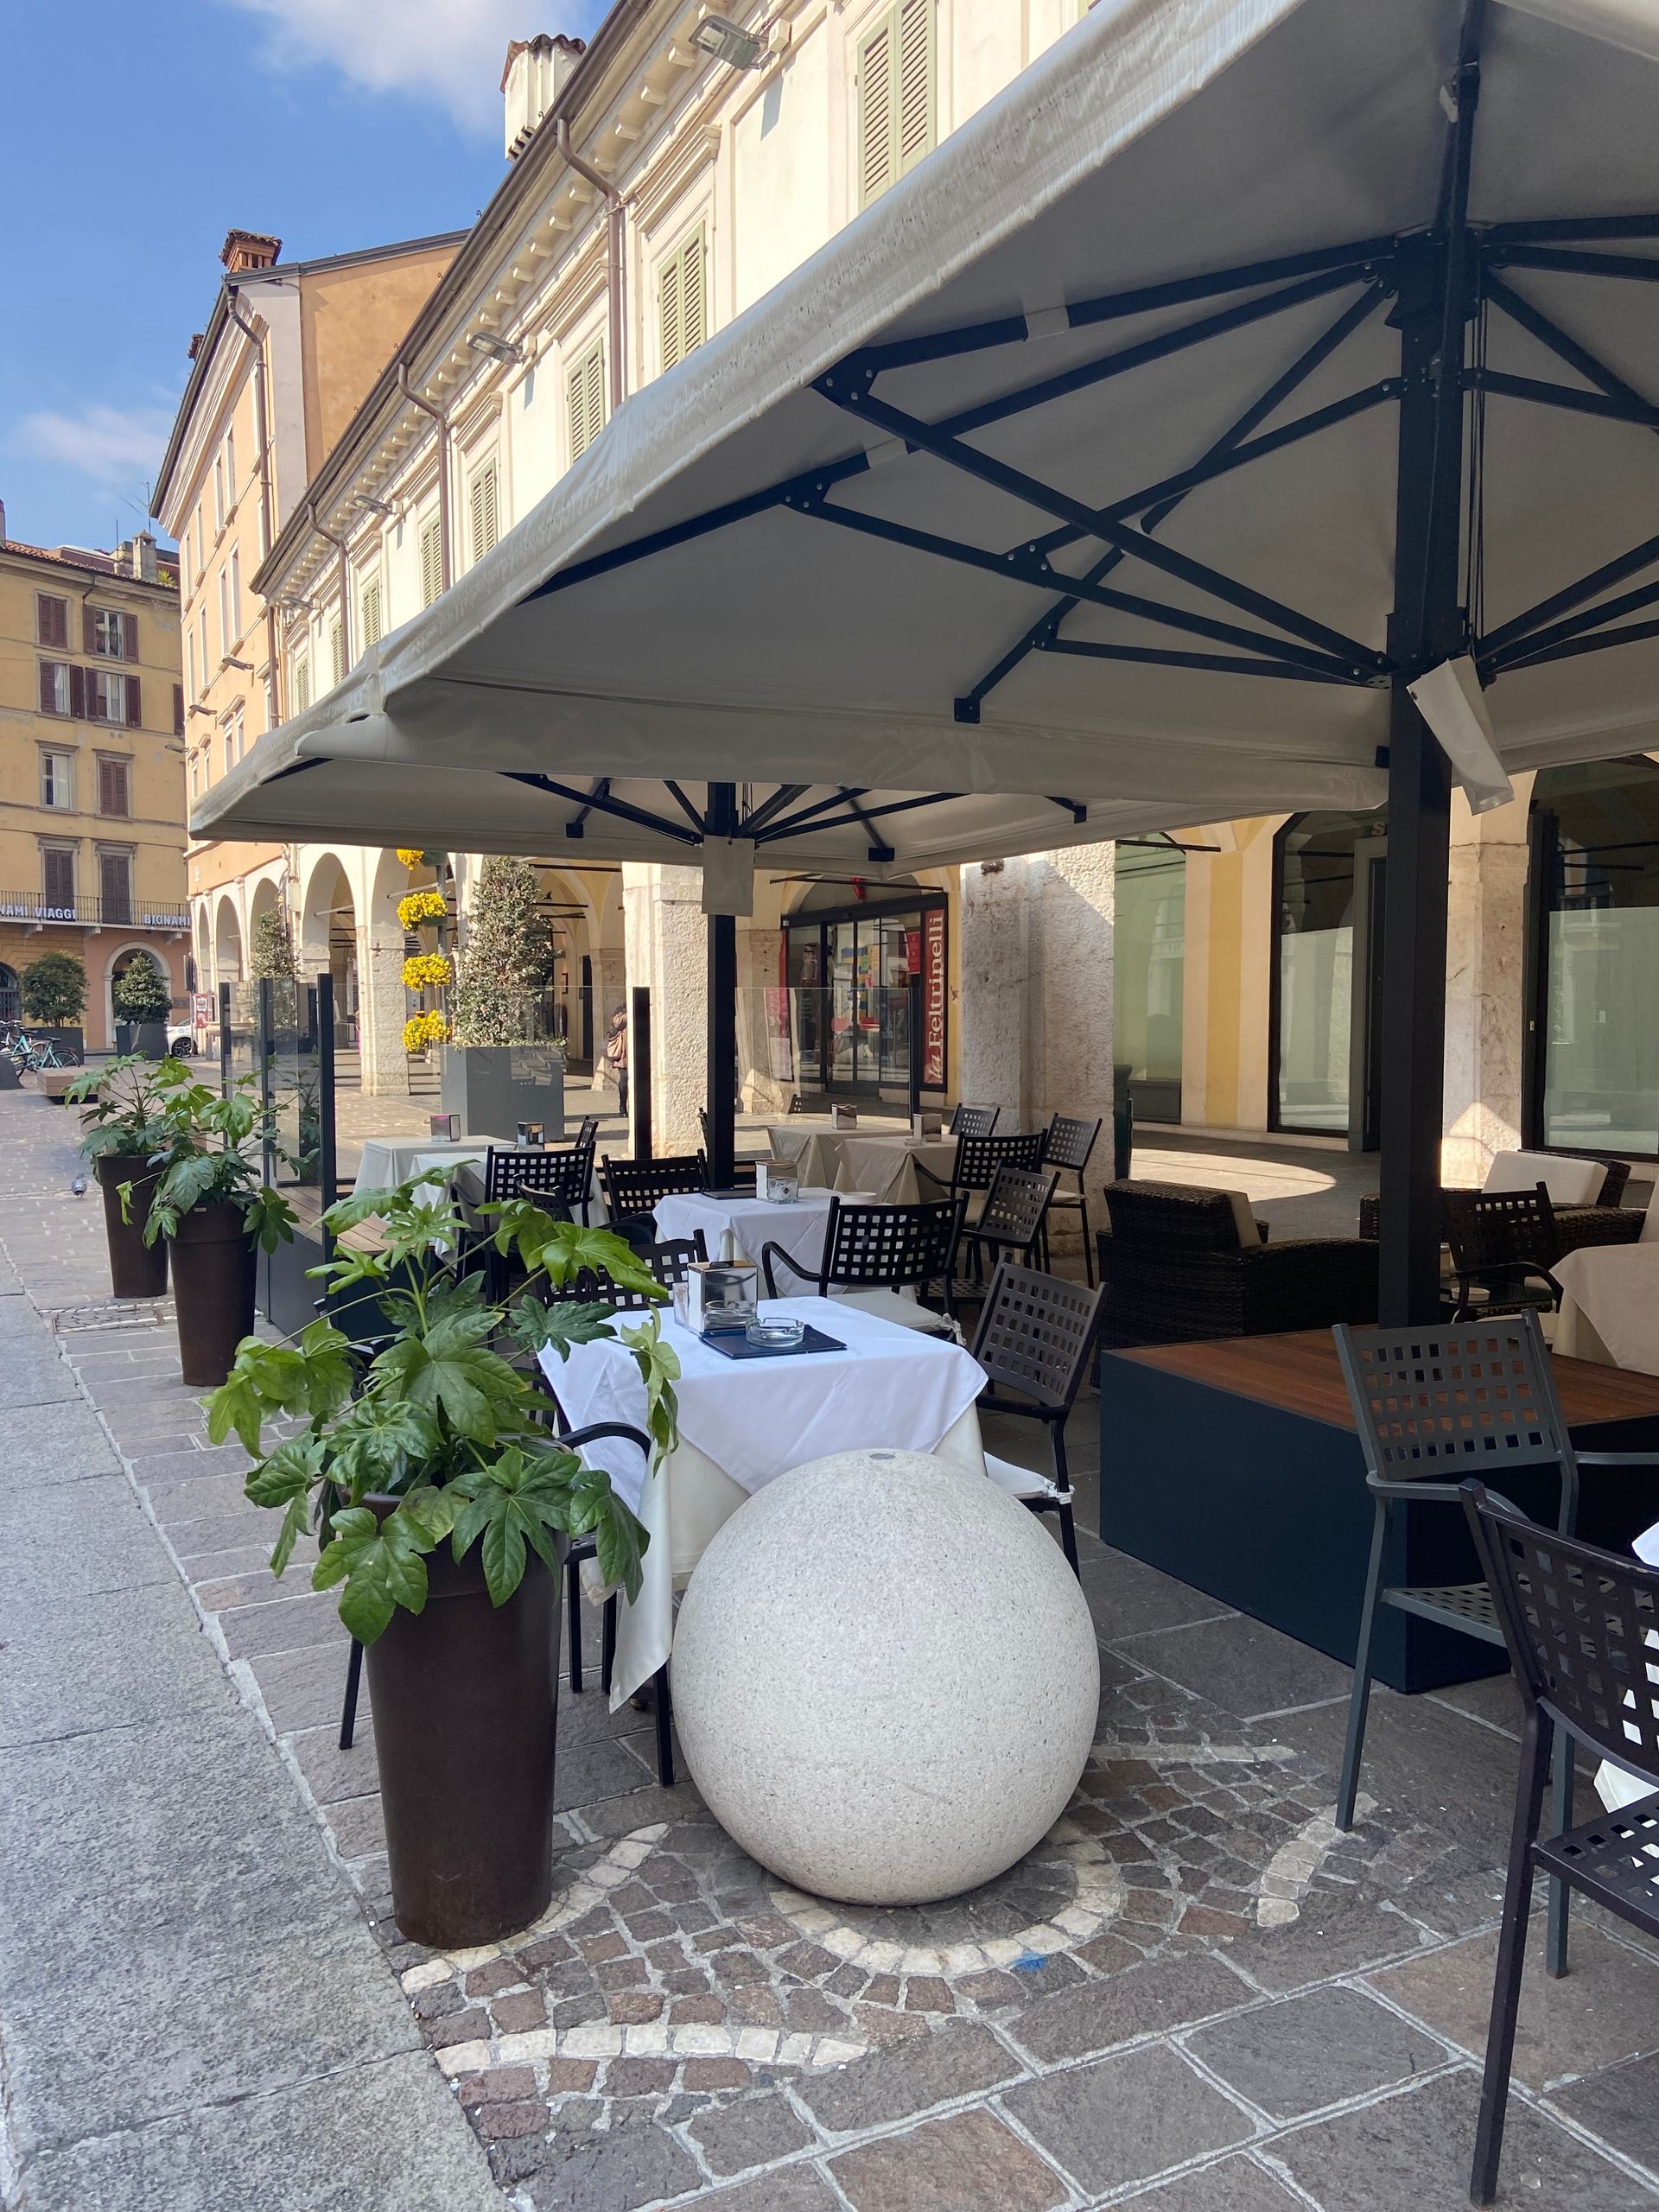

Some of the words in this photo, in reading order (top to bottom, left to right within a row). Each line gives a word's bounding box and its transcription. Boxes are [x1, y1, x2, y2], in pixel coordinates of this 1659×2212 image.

[35, 906, 76, 919] VIAGGI
[143, 913, 191, 926] BIGNAMI
[928, 916, 944, 1049] Feltrinelli
[928, 1053, 942, 1080] la
